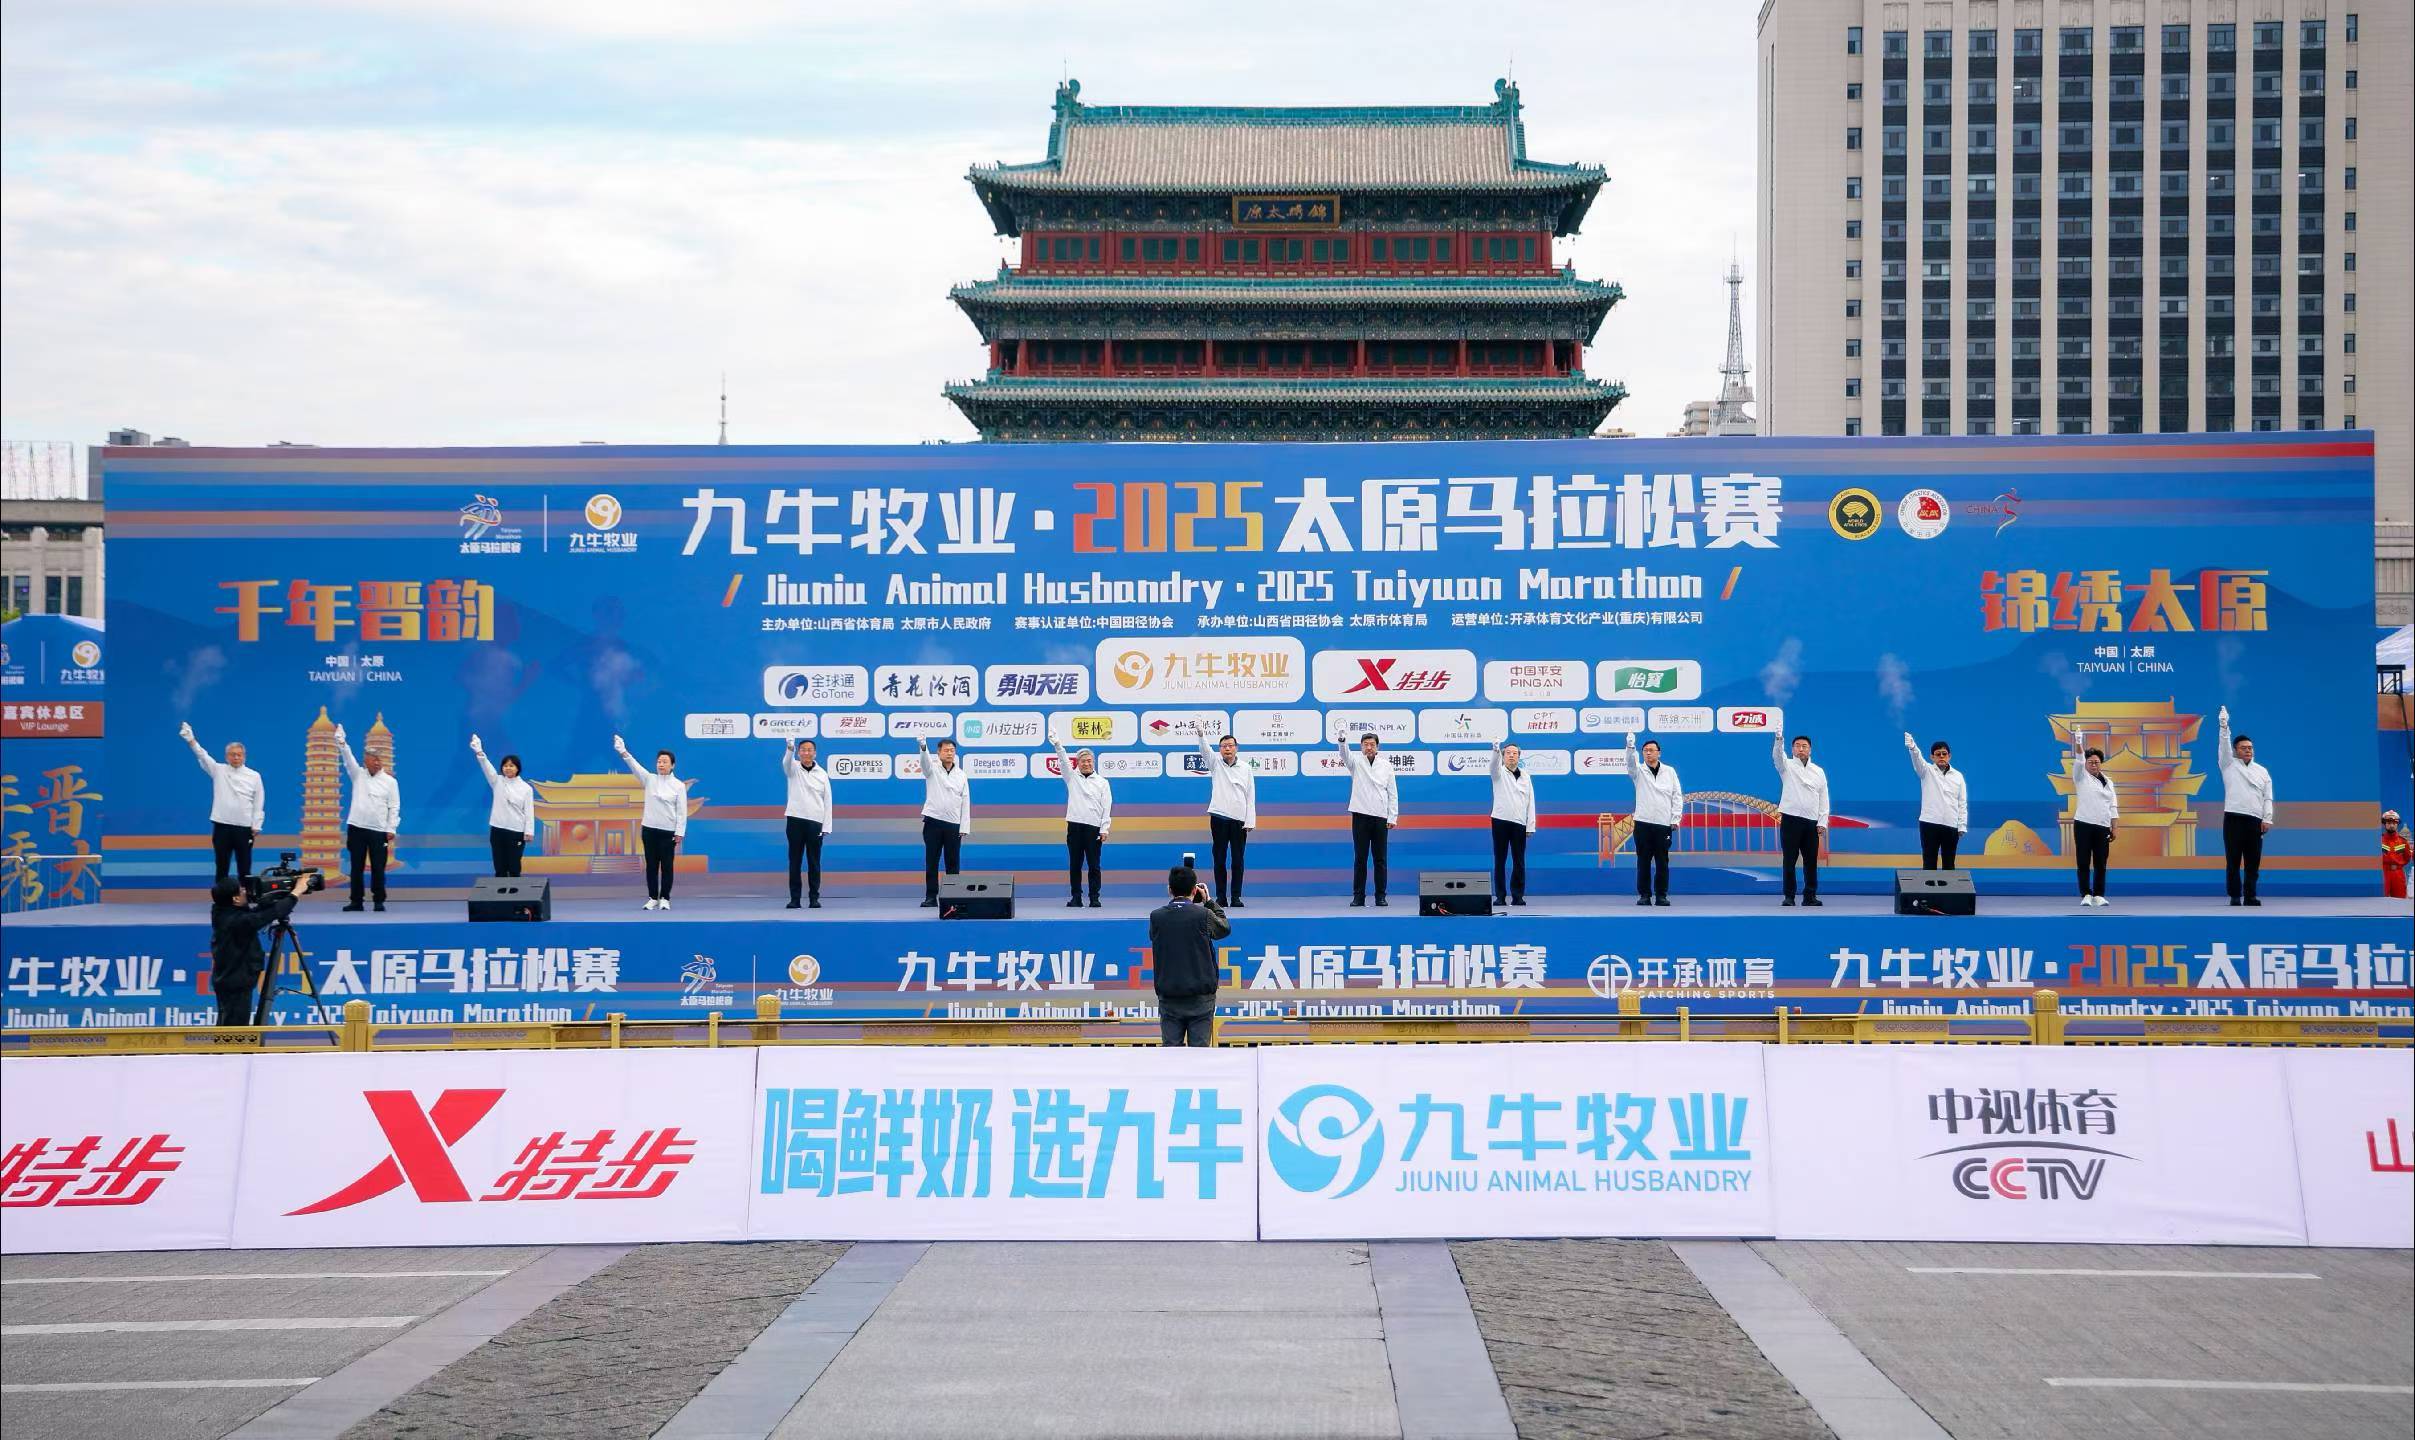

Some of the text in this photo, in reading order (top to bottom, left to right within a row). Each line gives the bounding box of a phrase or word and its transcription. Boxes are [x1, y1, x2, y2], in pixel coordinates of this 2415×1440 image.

[569, 533, 637, 547] 九牛牧业
[762, 573, 868, 605] Jiuniu
[885, 572, 1007, 605] Animal
[1024, 570, 1222, 609] Husbandry
[1257, 570, 1333, 602] 2025
[1351, 569, 1502, 609] Taiyuan
[1520, 567, 1702, 600] Marathon
[1980, 569, 2269, 632] 锦绣太原
[215, 579, 494, 641] 千年晋韵
[900, 616, 992, 630] 太原市人民政府
[1349, 613, 1428, 628] 太原市体育局
[2094, 646, 2155, 658] 中国 太原
[325, 656, 384, 668] 中国 太原
[1164, 652, 1290, 678] 九牛牧业
[1510, 665, 1563, 676] 中国平安
[2077, 662, 2174, 673] TAIYUAN CHINA
[309, 671, 402, 682] TAIYUAN CHINA
[811, 673, 855, 688] 全球通
[882, 672, 971, 698] 青花汾酒
[997, 673, 1079, 696] 勇闯天涯
[1162, 680, 1289, 689] JIUNIU ANIMAL HUSBANDRY
[1392, 670, 1451, 691] 特步
[811, 689, 854, 699] GoTone
[3, 705, 84, 720] 嘉宾休息区
[20, 721, 69, 732] VIP Lounge
[986, 723, 1037, 735] 小拉出行
[1076, 721, 1104, 736] 紫林
[1638, 957, 1775, 988] 开承体育
[775, 987, 834, 1001] 九牛牧业
[1638, 990, 1775, 999] CATCHING SPORTS
[4, 1008, 70, 1027] Jiuniu
[79, 1007, 156, 1027] Animal
[463, 1003, 572, 1023] Marathon
[1018, 1001, 1090, 1018] Animal
[1237, 1000, 1284, 1016] 2025
[1393, 1000, 1501, 1016] Marathon
[1956, 1000, 2029, 1015] Animal
[2056, 998, 2164, 1017] usbandry
[2185, 999, 2233, 1016] 2025
[2244, 999, 2339, 1016] Taiyuan
[1927, 1087, 2119, 1136] 中视体育
[1399, 1092, 1752, 1161] 九牛牧业
[760, 1088, 1244, 1199] 喝鲜奶 选九牛
[1, 1134, 186, 1207] 特步
[478, 1126, 697, 1202] 特步
[1395, 1168, 1753, 1193] JIUNIU ANIMAL HUSBANDRY
[1952, 1157, 2106, 1200] CCTV
